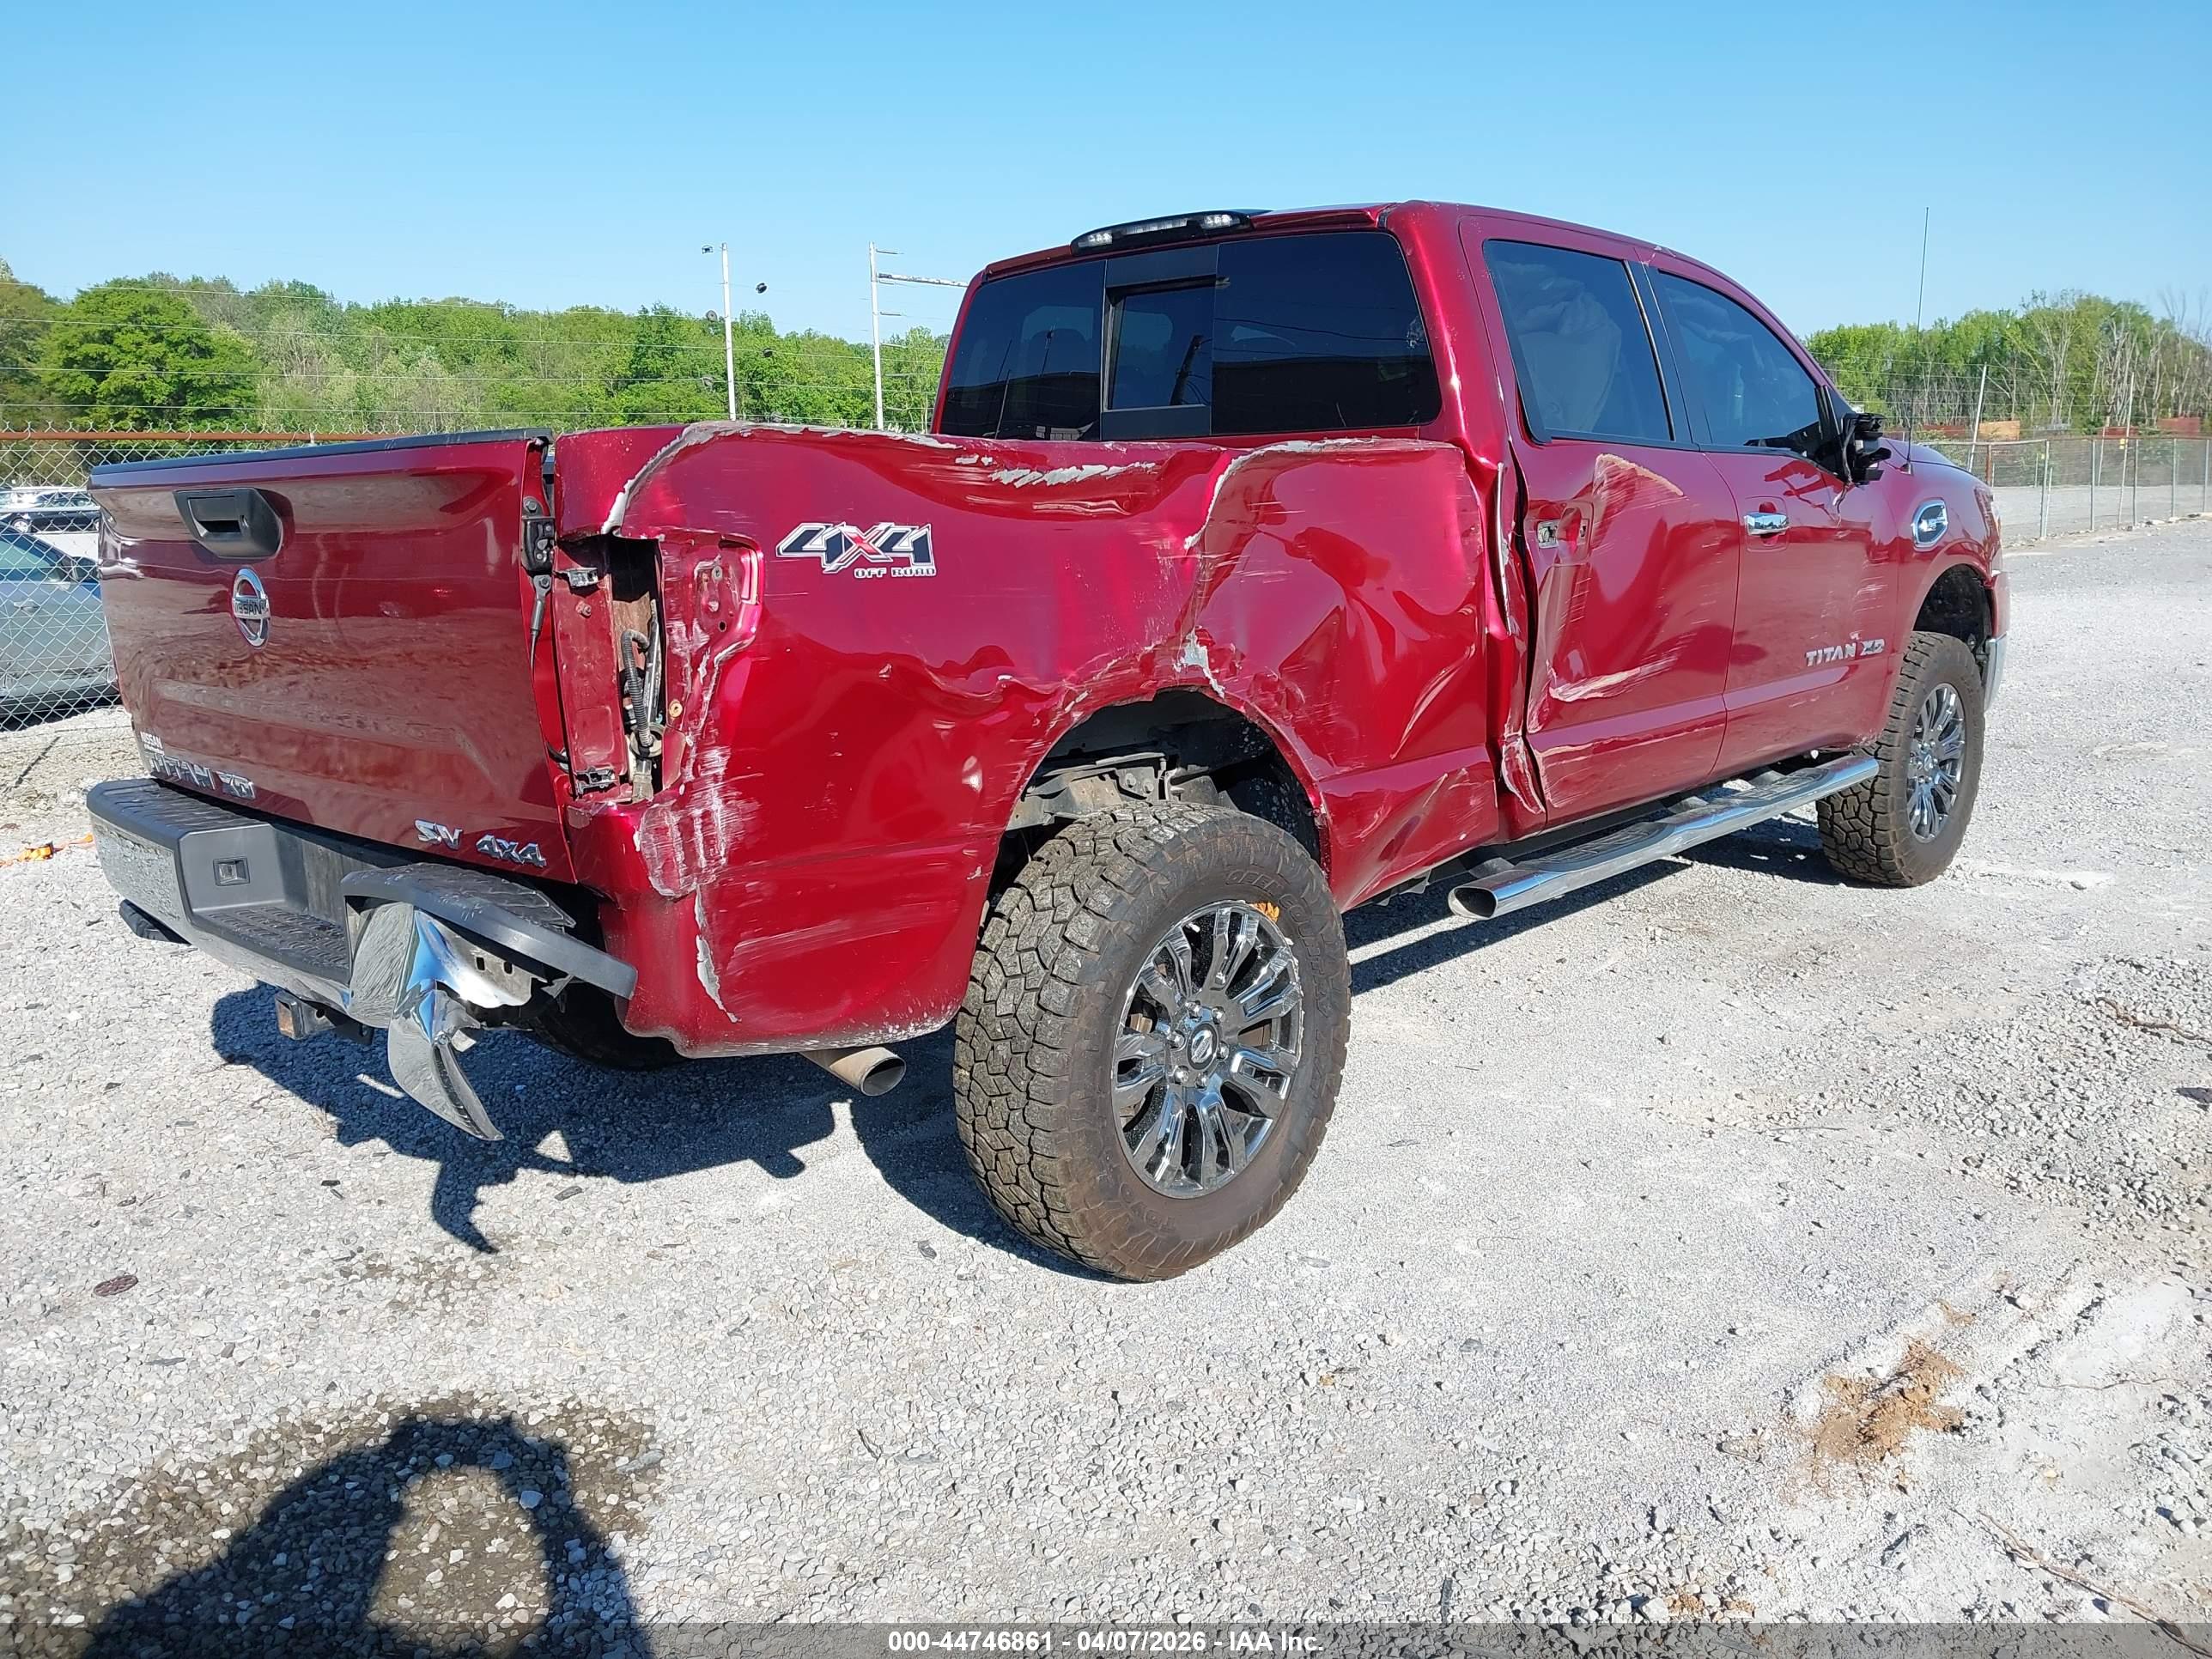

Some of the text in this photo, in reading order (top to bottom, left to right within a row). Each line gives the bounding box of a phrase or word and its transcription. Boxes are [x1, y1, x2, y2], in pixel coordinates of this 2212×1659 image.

[854, 566, 937, 579] OFF ROAD
[1806, 639, 1885, 667] TITAN XD
[149, 752, 257, 799] TITAN XD
[415, 818, 464, 850] SV
